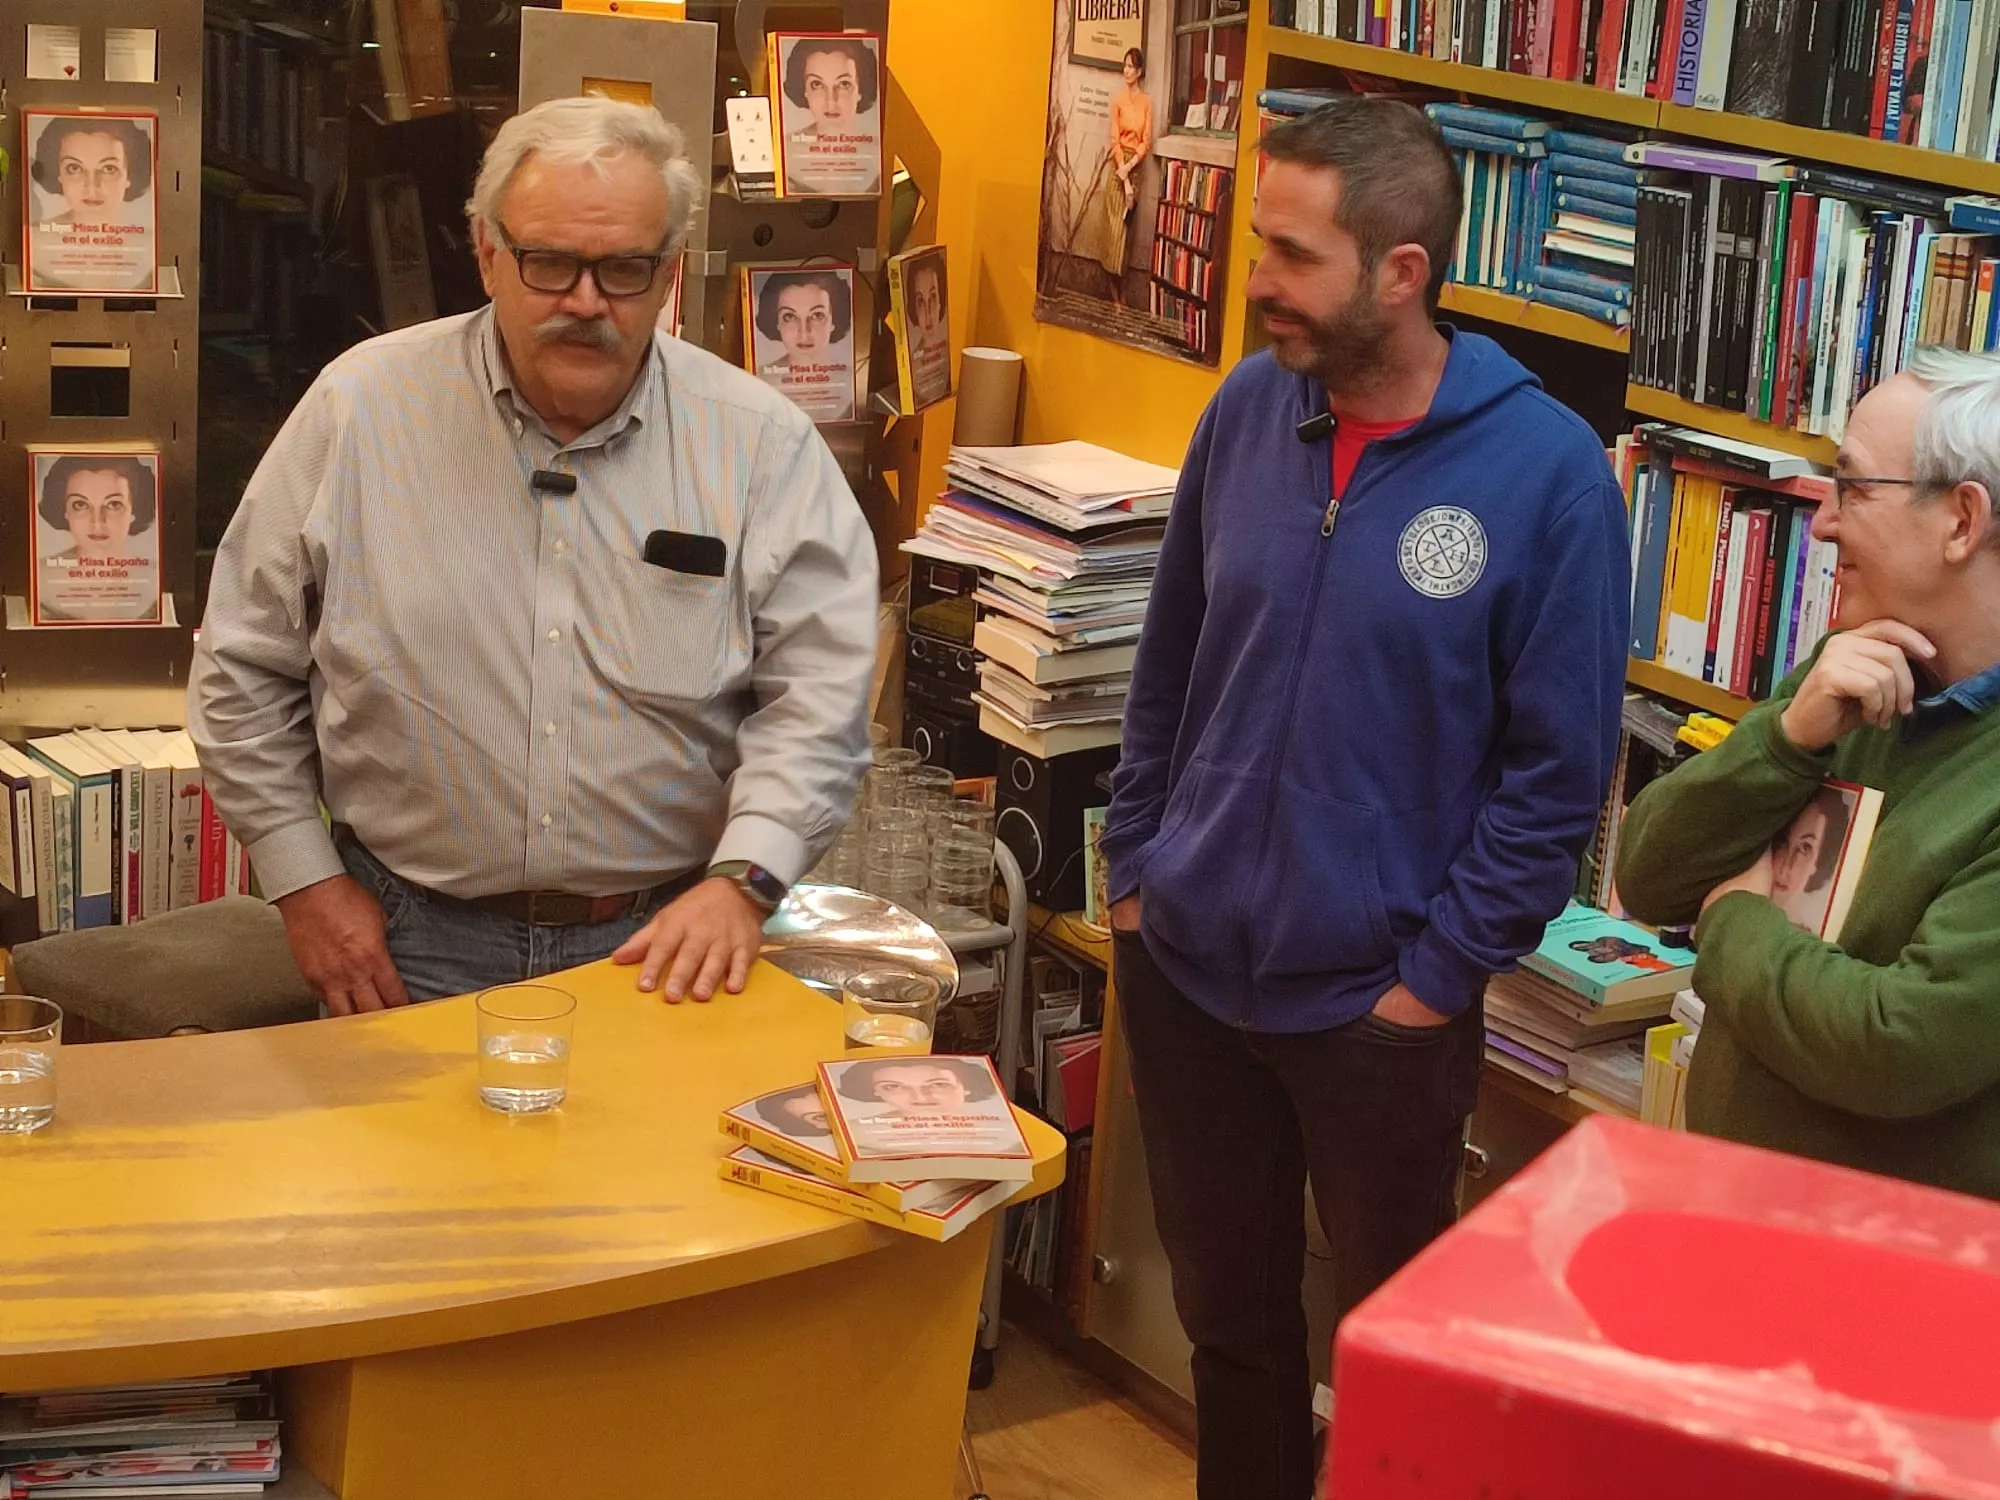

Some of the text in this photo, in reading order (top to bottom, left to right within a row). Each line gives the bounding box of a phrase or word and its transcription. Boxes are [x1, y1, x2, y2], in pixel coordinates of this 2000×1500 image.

[1676, 0, 1702, 92] HISTORIA
[1889, 73, 1904, 88] EL
[839, 133, 873, 143] España
[72, 223, 99, 232] Miss
[101, 223, 145, 235] España
[62, 235, 124, 245] en el exilio
[789, 363, 810, 372] Miss
[813, 363, 846, 373] España
[1714, 501, 1732, 581] Dolly Parton
[79, 557, 104, 566] Miss
[106, 557, 149, 567] España
[68, 569, 128, 578] en el exilio
[941, 1114, 1000, 1122] España
